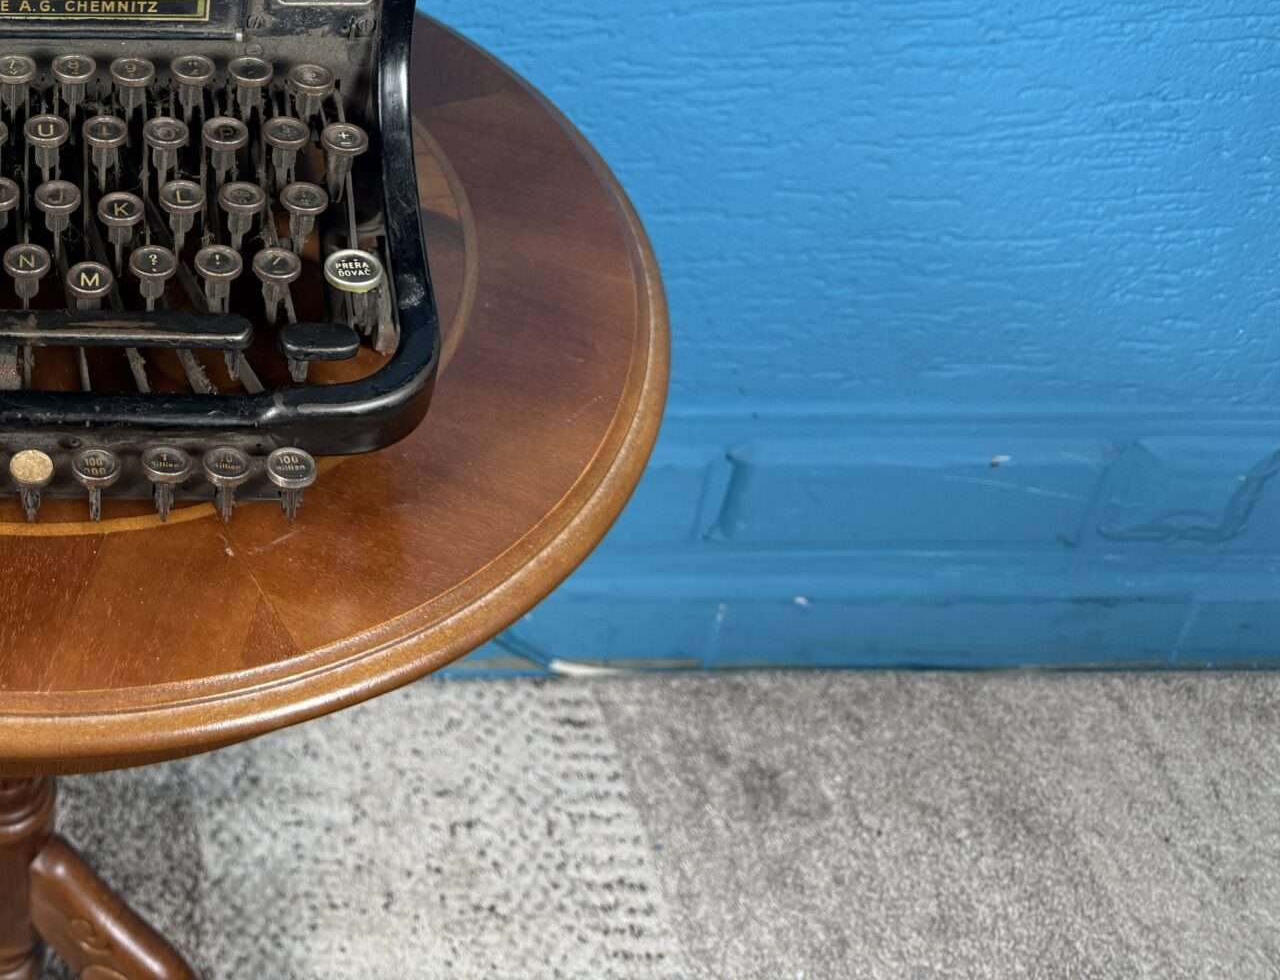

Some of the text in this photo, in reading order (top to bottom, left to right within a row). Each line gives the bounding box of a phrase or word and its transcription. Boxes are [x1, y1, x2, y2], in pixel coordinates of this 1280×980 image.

[64, 0, 159, 13] CHEMNITZ
[37, 123, 54, 137] U
[176, 189, 193, 203] L
[113, 202, 129, 217] K
[19, 253, 36, 269] N
[79, 271, 100, 287] M
